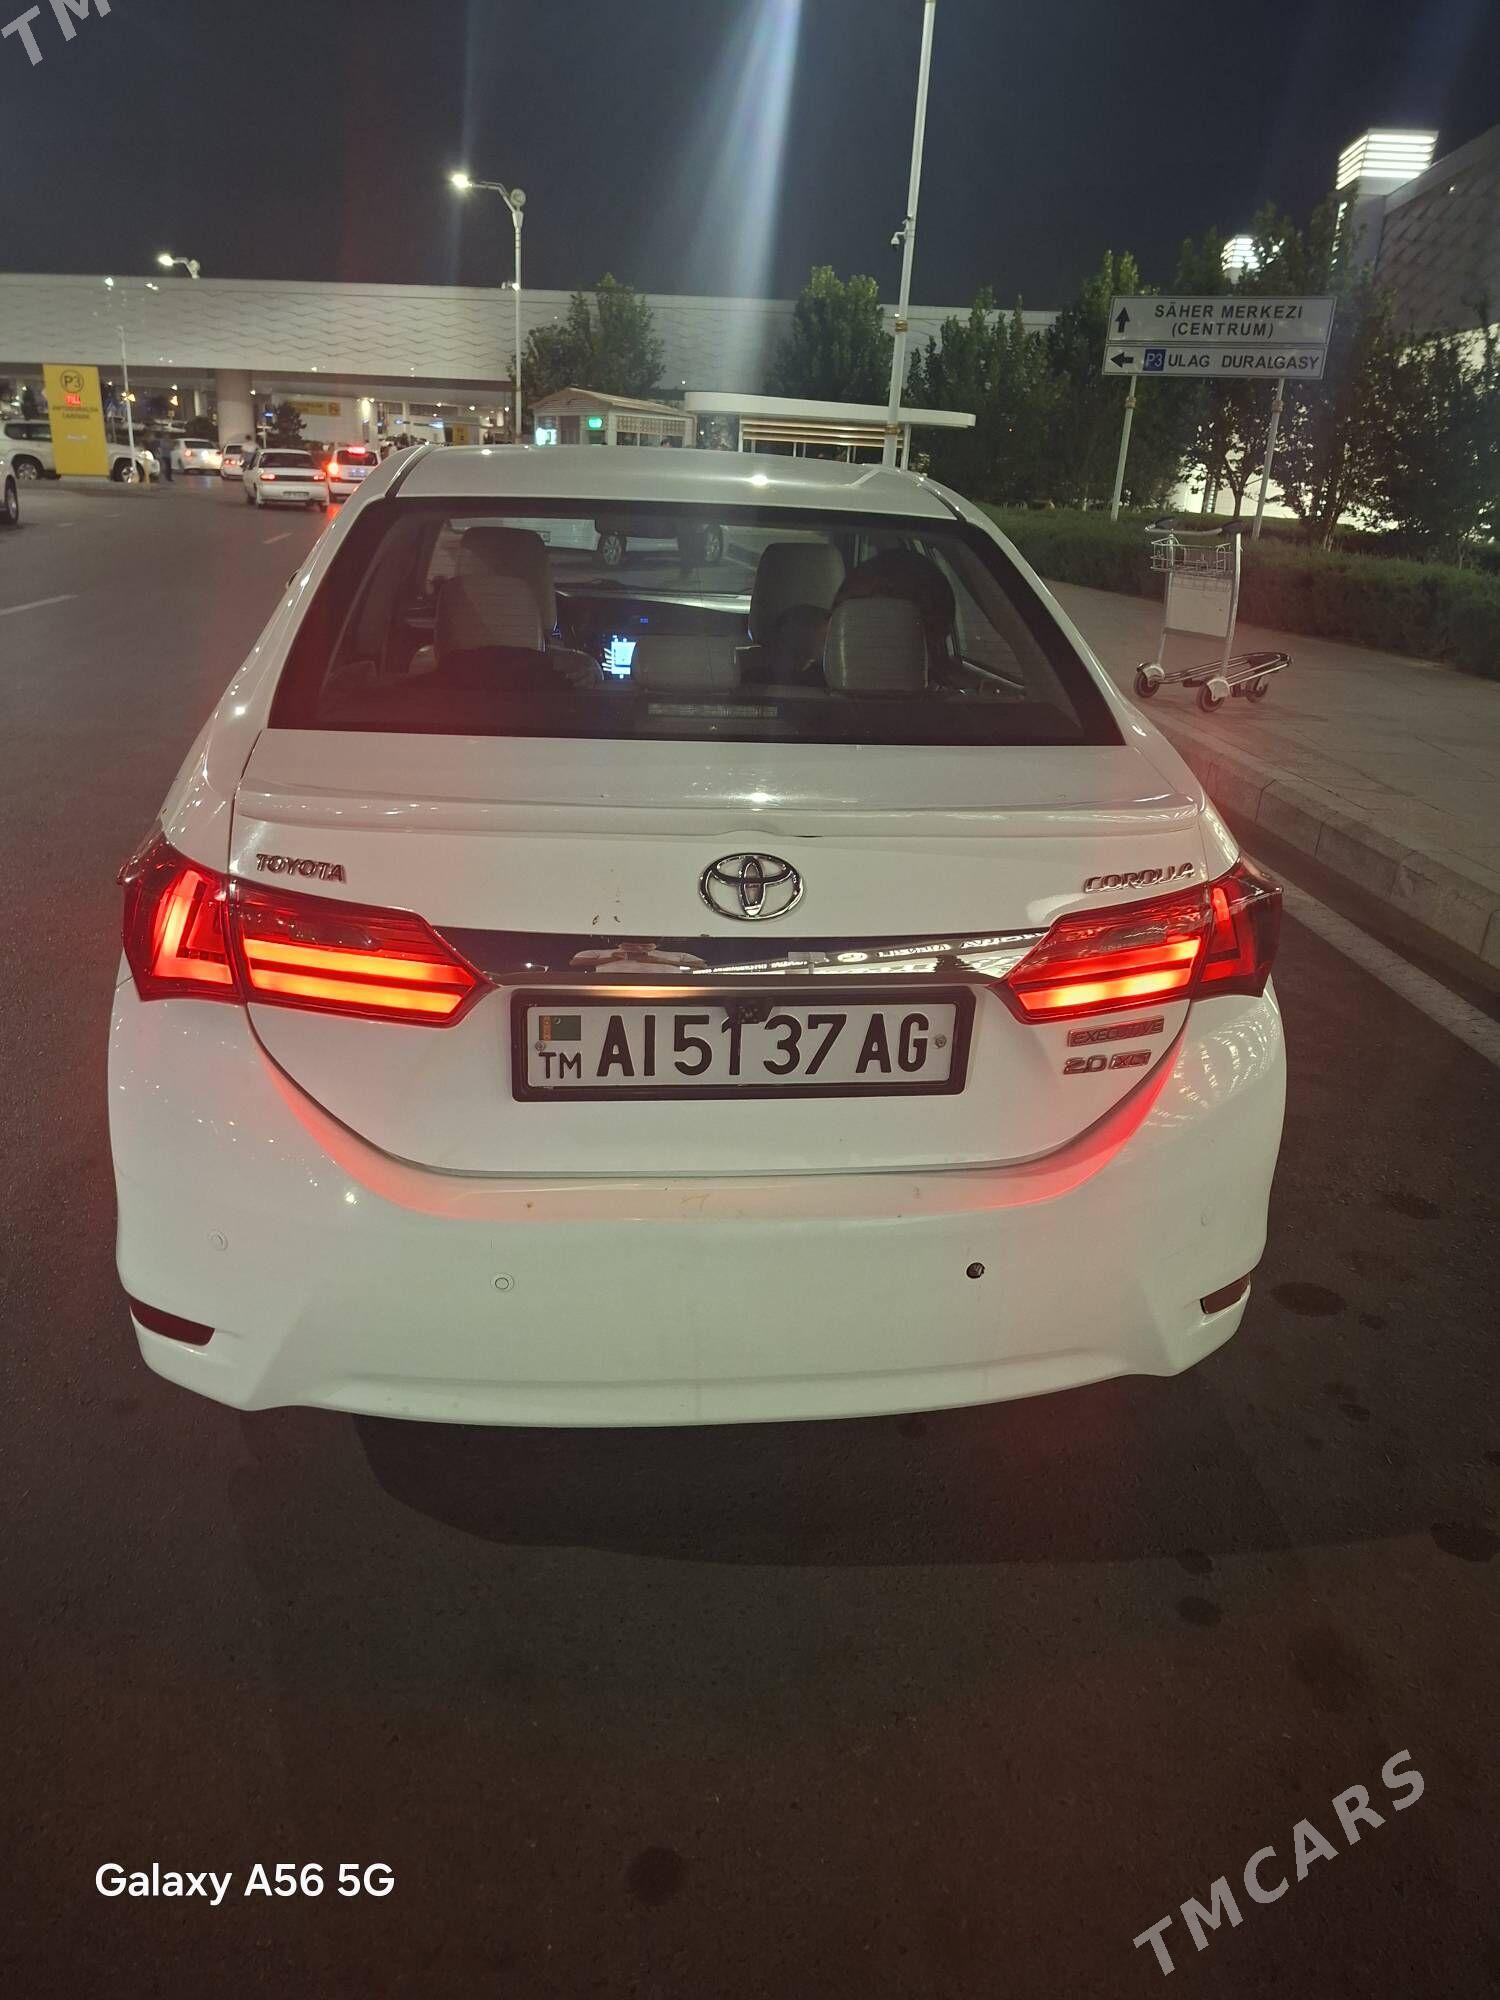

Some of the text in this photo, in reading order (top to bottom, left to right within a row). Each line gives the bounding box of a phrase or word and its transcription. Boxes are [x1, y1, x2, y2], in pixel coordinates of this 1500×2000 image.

[1221, 304, 1303, 320] MERKEZI
[1171, 321, 1275, 338] (CENTRUM)
[1146, 351, 1320, 370] P3 ULAG DURALGASY
[63, 375, 81, 389] P3
[256, 853, 346, 882] TOYOTA
[1083, 862, 1196, 893] COROLLA
[538, 1052, 582, 1079] TM
